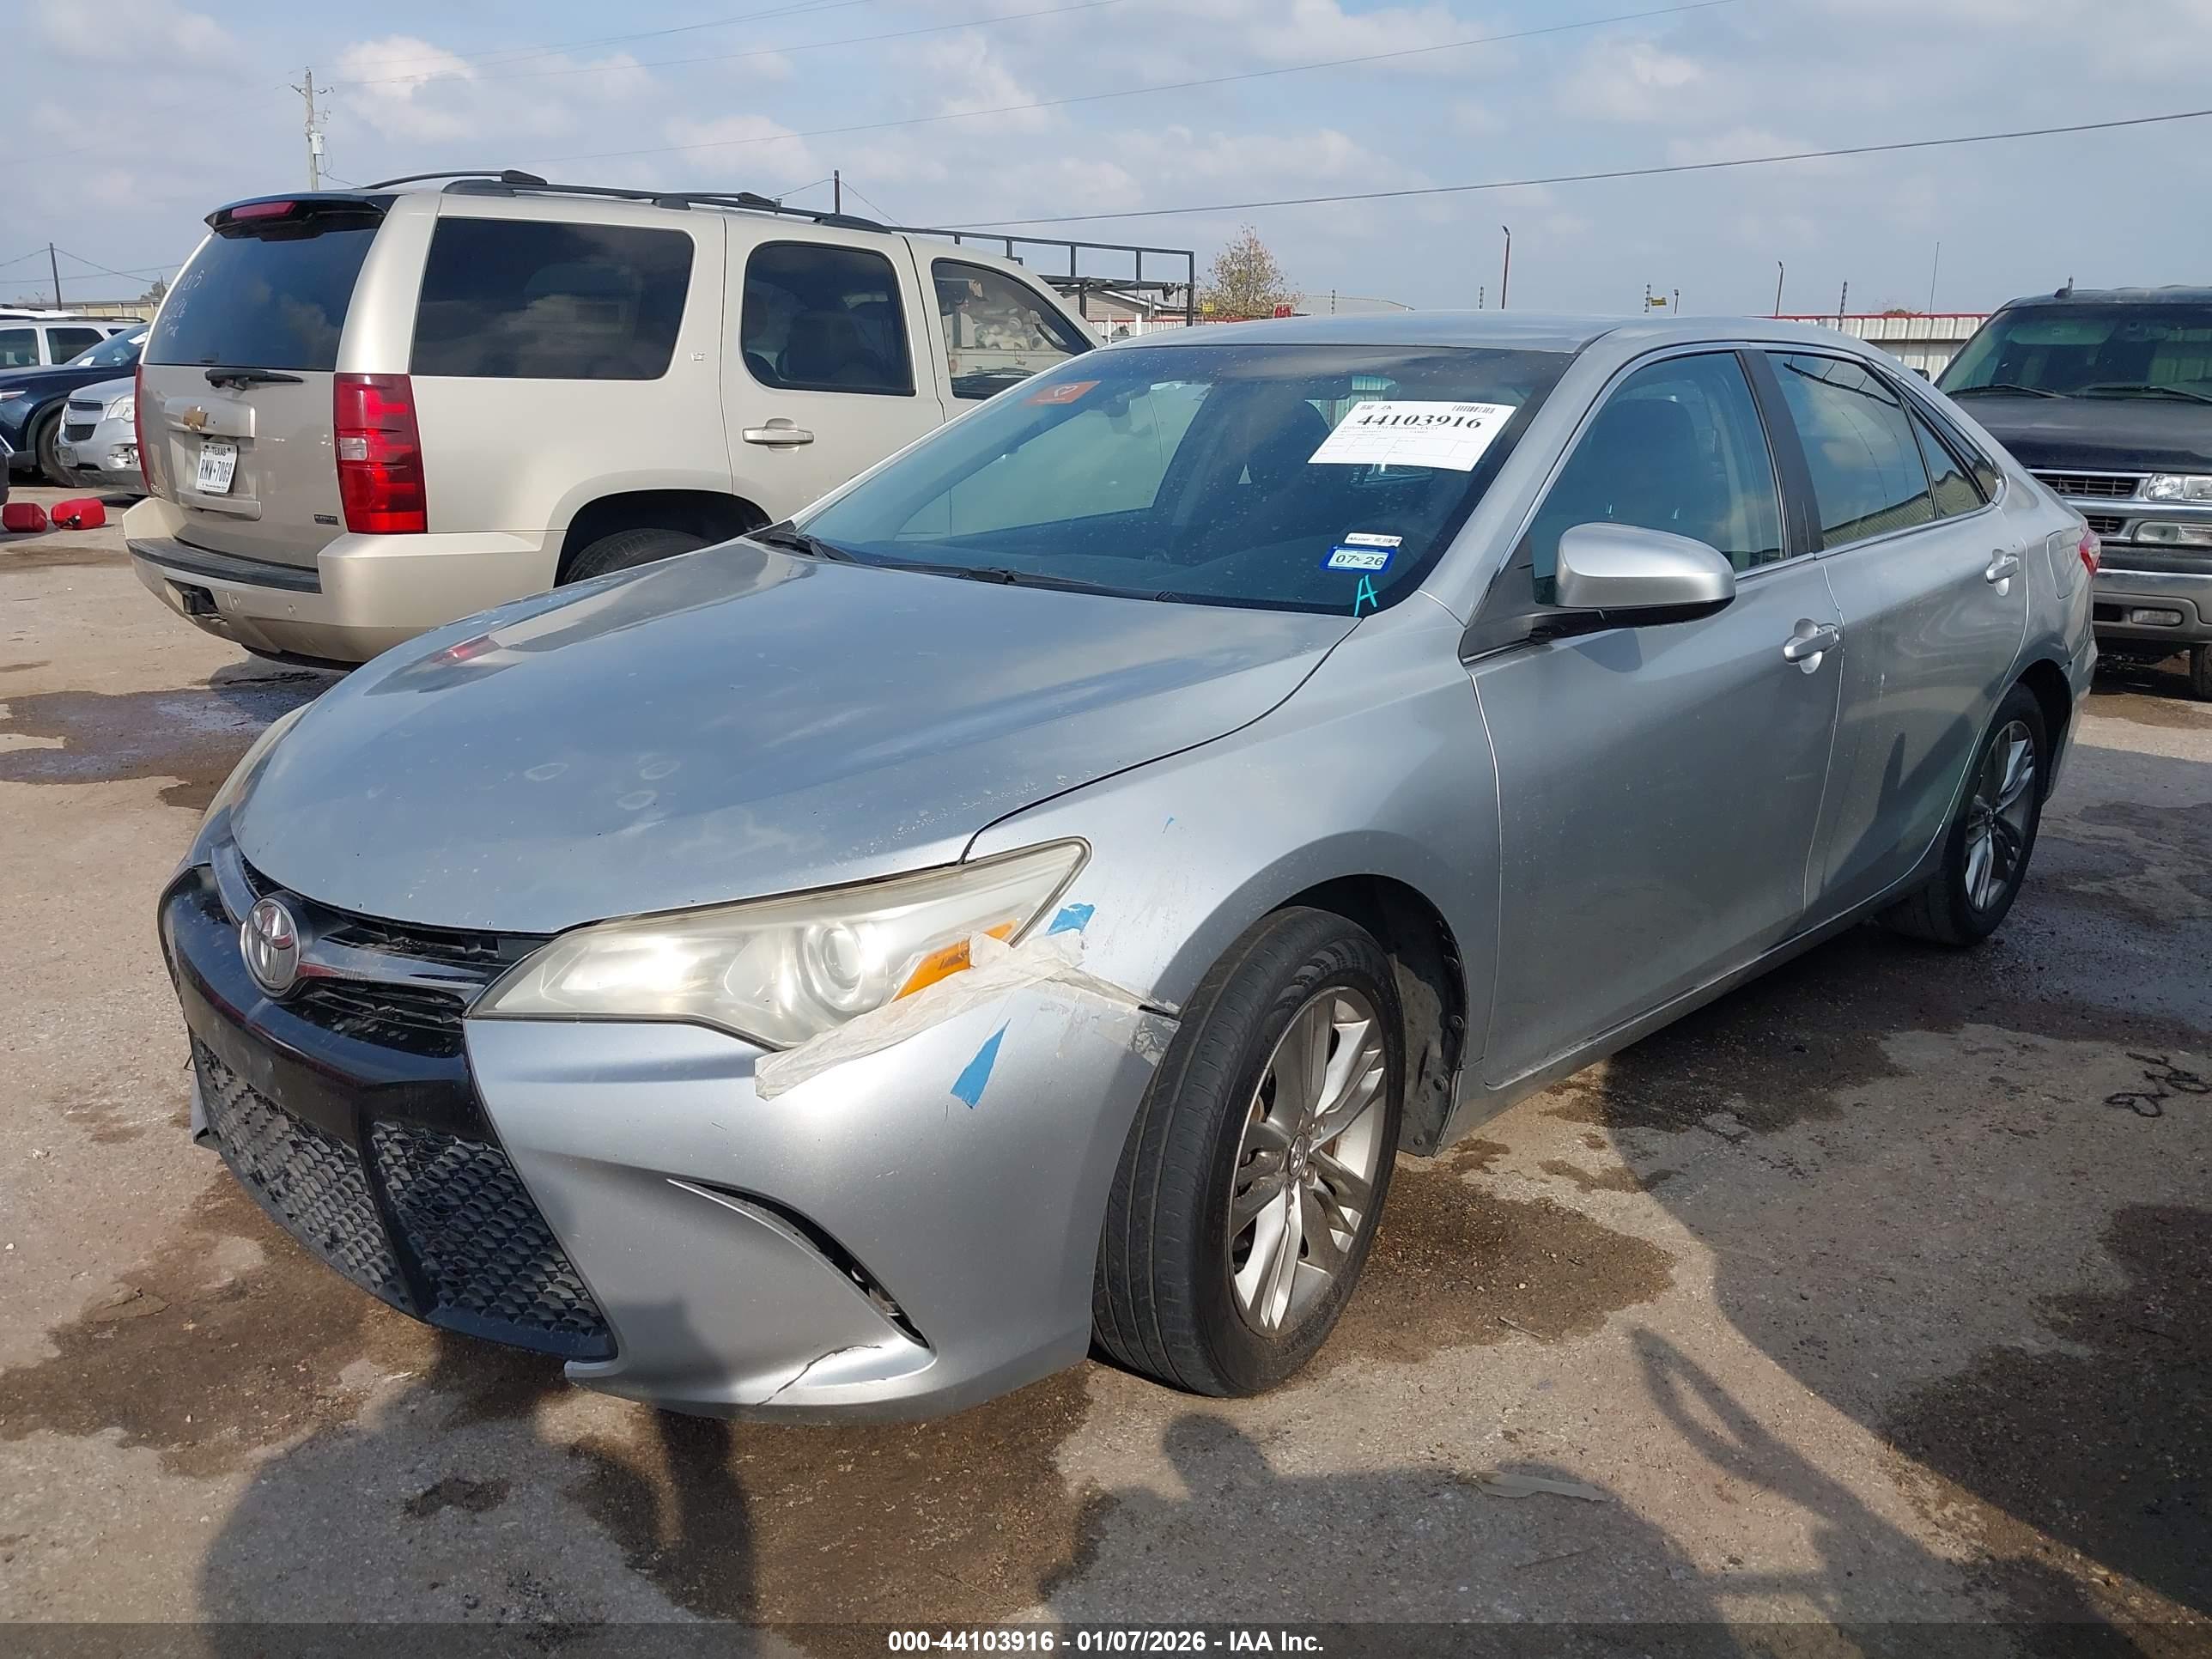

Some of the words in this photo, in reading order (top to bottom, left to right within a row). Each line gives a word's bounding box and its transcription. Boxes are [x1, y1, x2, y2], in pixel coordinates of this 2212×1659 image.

[1357, 414, 1486, 429] 44103916
[211, 446, 228, 457] TEXAS
[1335, 554, 1357, 563] 07
[1363, 556, 1385, 566] 26
[1353, 574, 1379, 617] A
